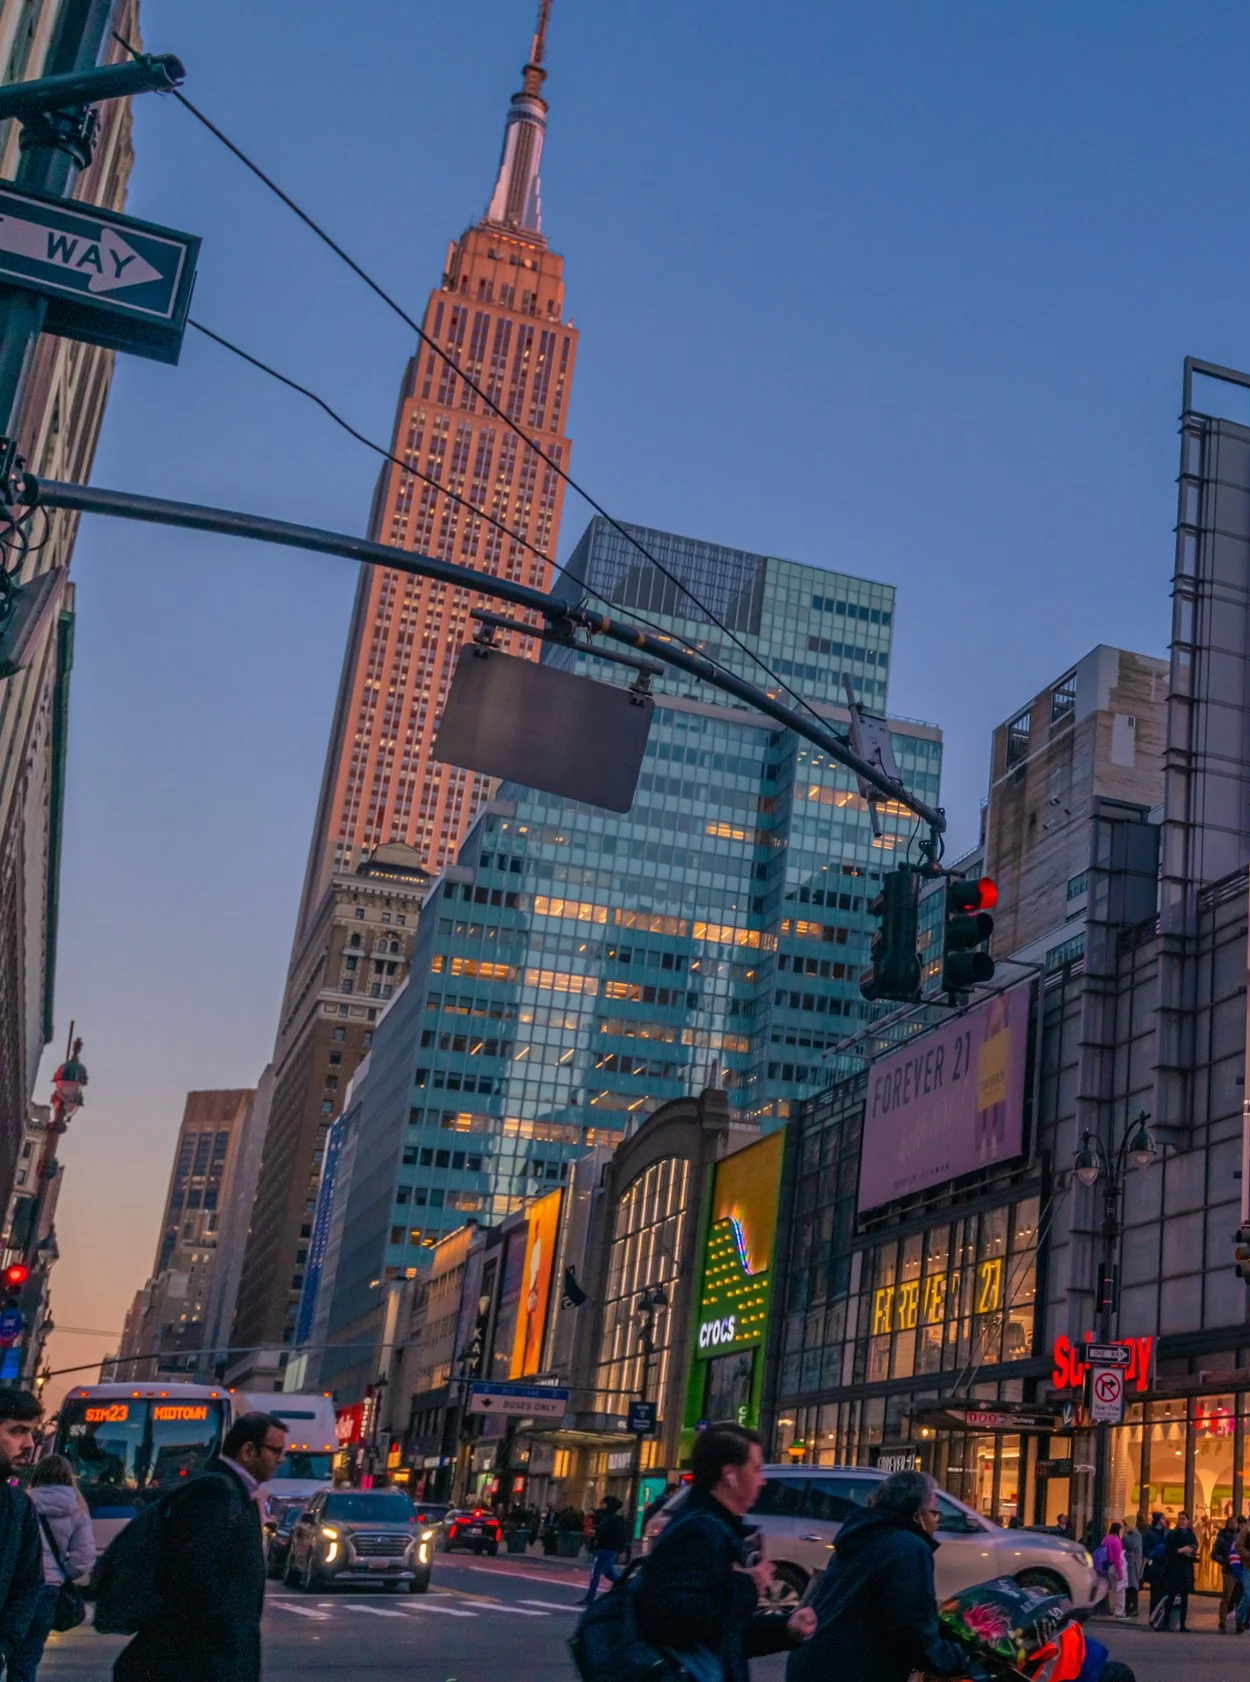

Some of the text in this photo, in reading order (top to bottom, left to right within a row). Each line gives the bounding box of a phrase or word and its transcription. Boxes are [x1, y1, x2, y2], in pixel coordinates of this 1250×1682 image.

[47, 231, 136, 279] WAY
[872, 1030, 972, 1119] FOREVER 21
[979, 1258, 1002, 1314] 21
[699, 1315, 735, 1348] crocs
[1052, 1327, 1153, 1392] Suay
[84, 1404, 208, 1422] SIM23 MIDTOWN
[502, 1400, 557, 1412] BUSES ONLY
